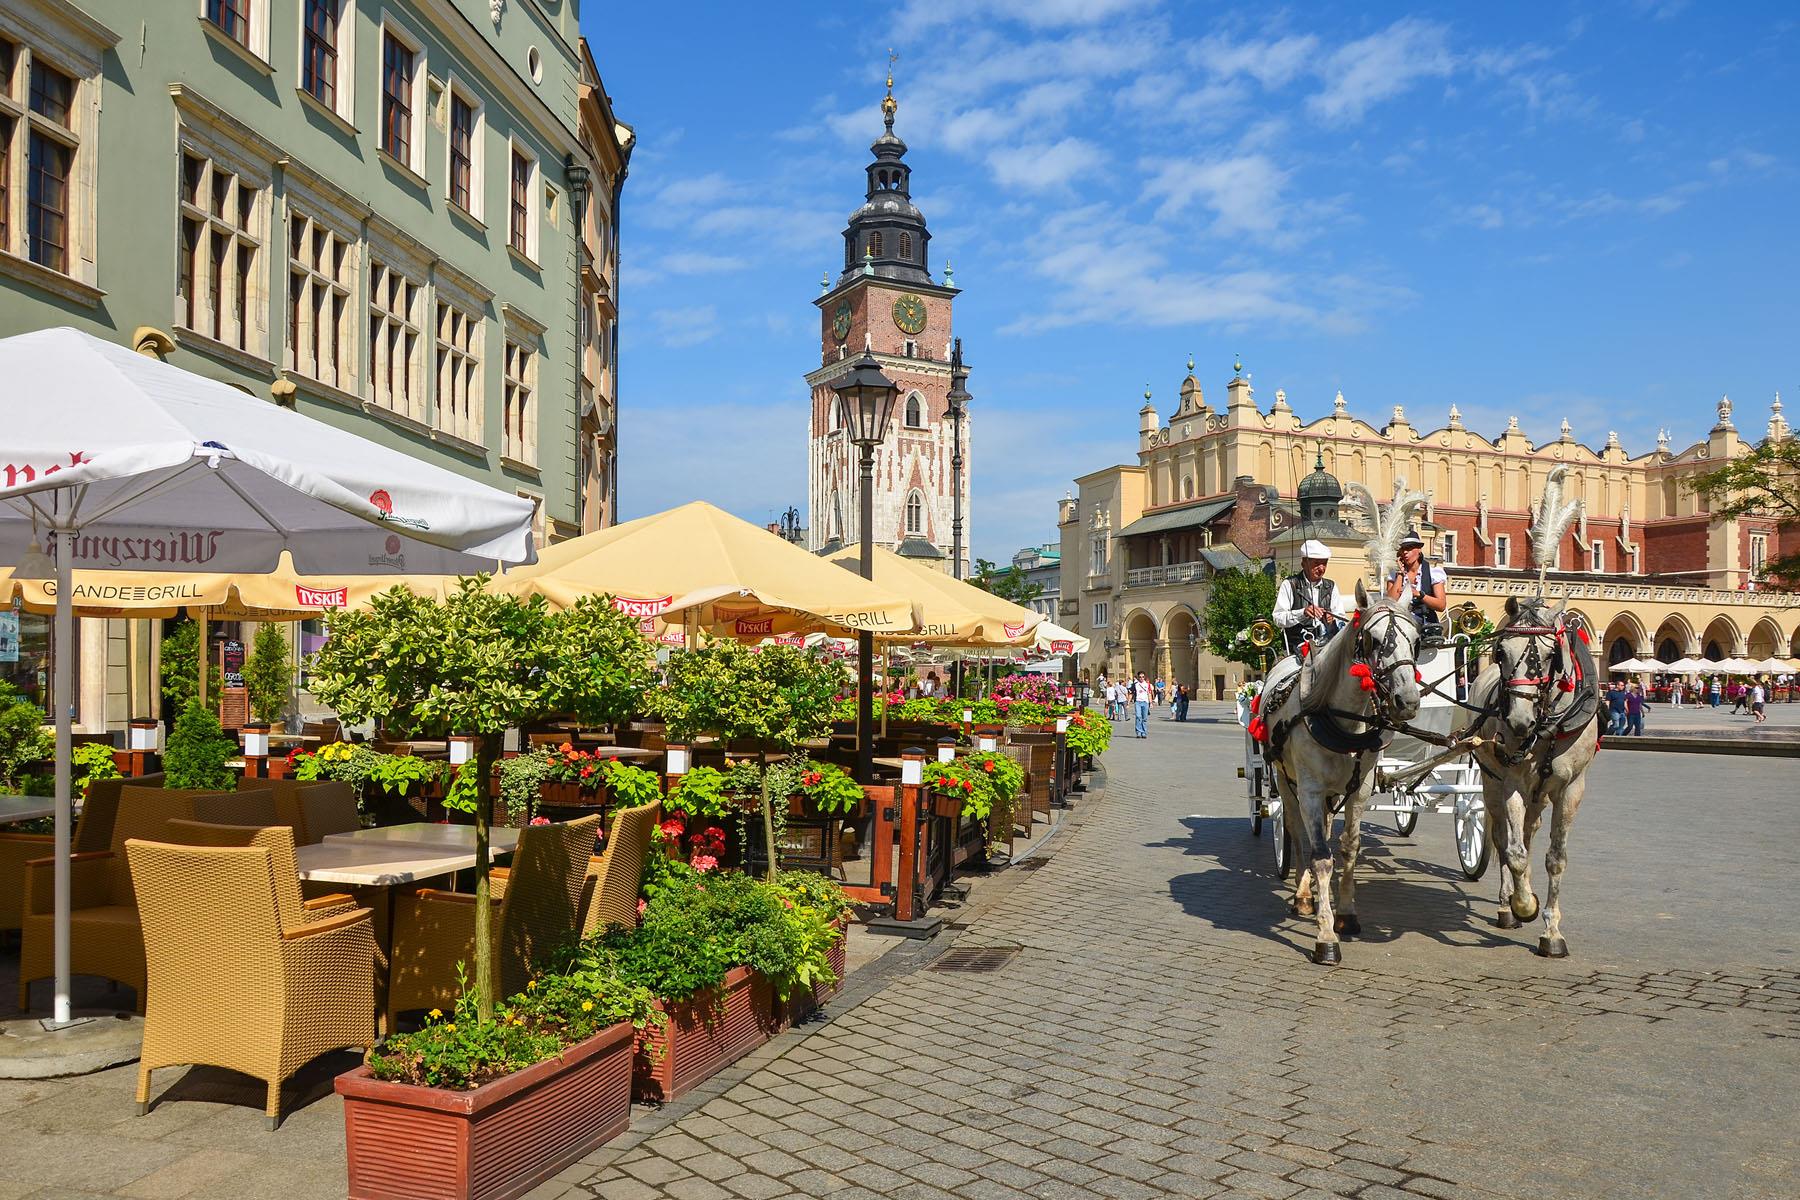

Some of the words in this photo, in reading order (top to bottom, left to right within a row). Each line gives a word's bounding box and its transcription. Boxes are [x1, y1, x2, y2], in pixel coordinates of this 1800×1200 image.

[43, 581, 132, 600] GANDE
[147, 583, 203, 600] GRILL
[299, 589, 345, 605] TYSKIE
[845, 610, 893, 627] GRILL
[738, 620, 770, 634] TYSKIE
[919, 623, 959, 636] GRILL
